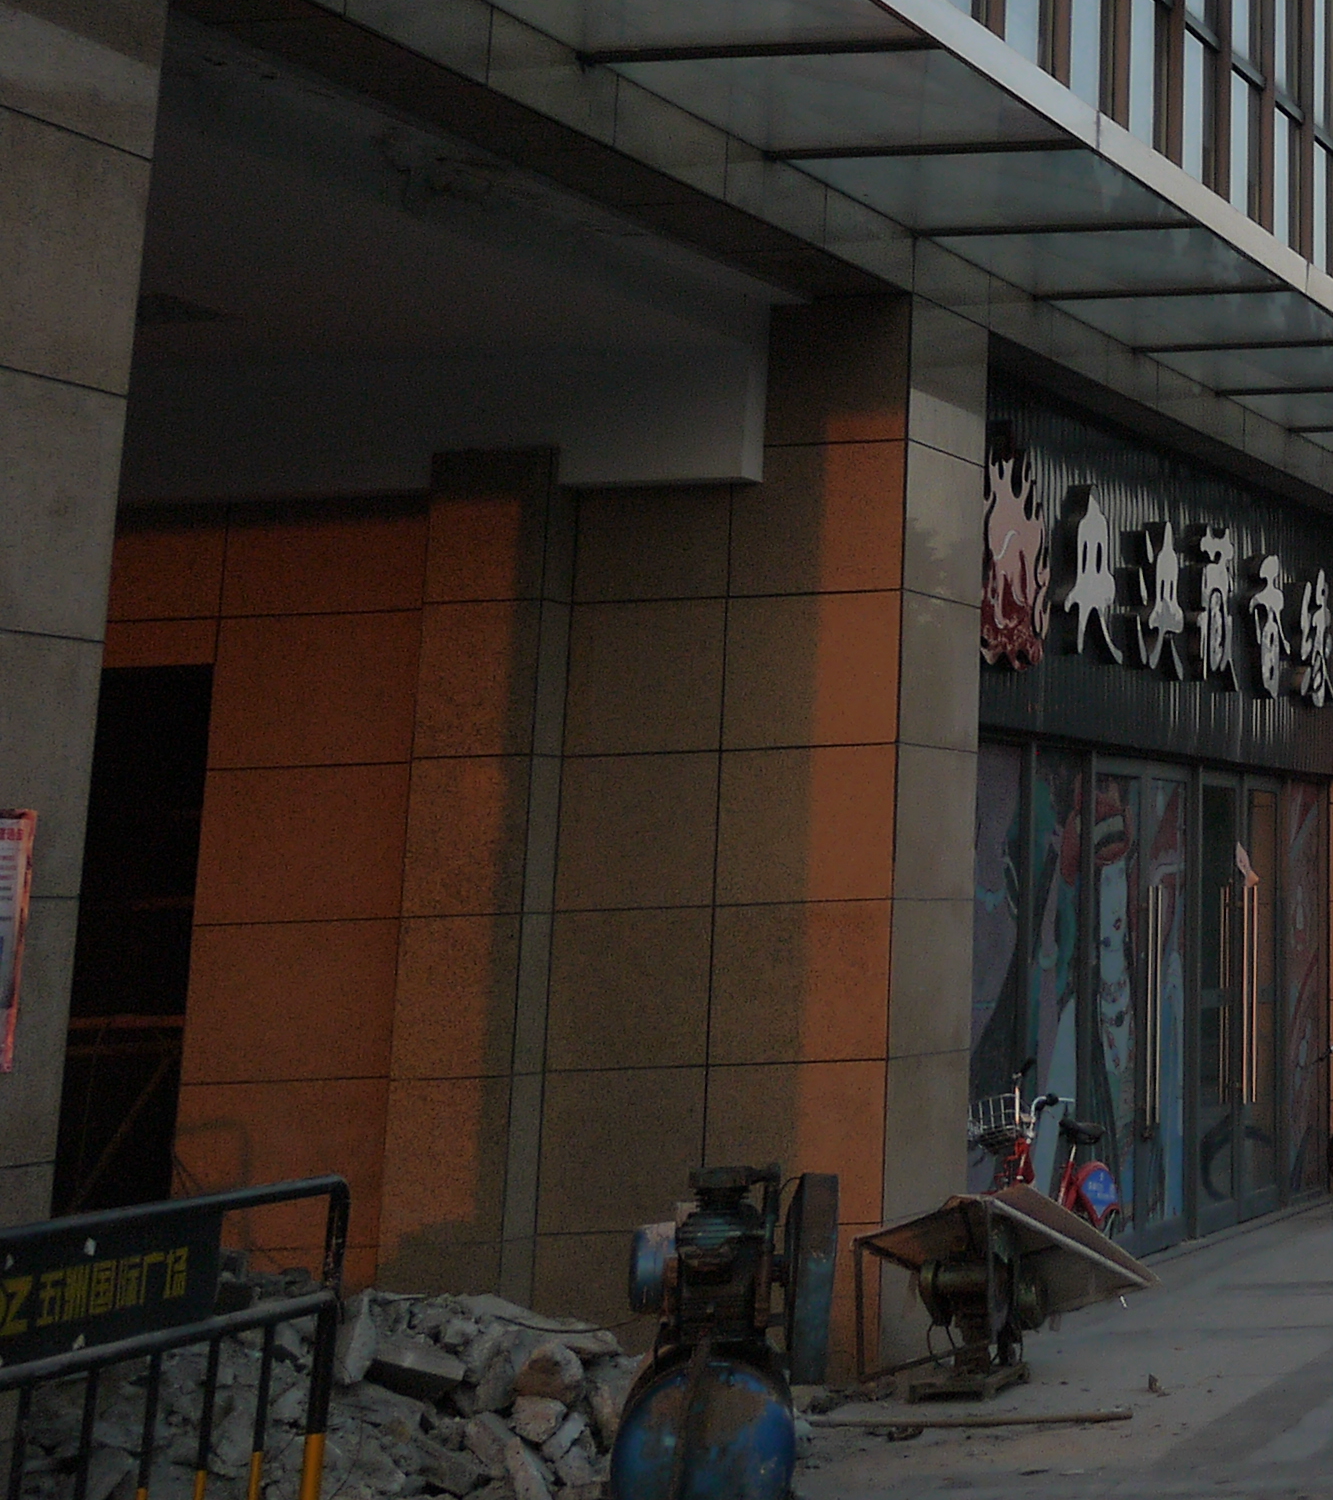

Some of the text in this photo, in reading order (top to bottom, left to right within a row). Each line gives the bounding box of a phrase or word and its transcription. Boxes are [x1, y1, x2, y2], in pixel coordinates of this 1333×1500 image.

[35, 1246, 190, 1328] 五洲国际广场
